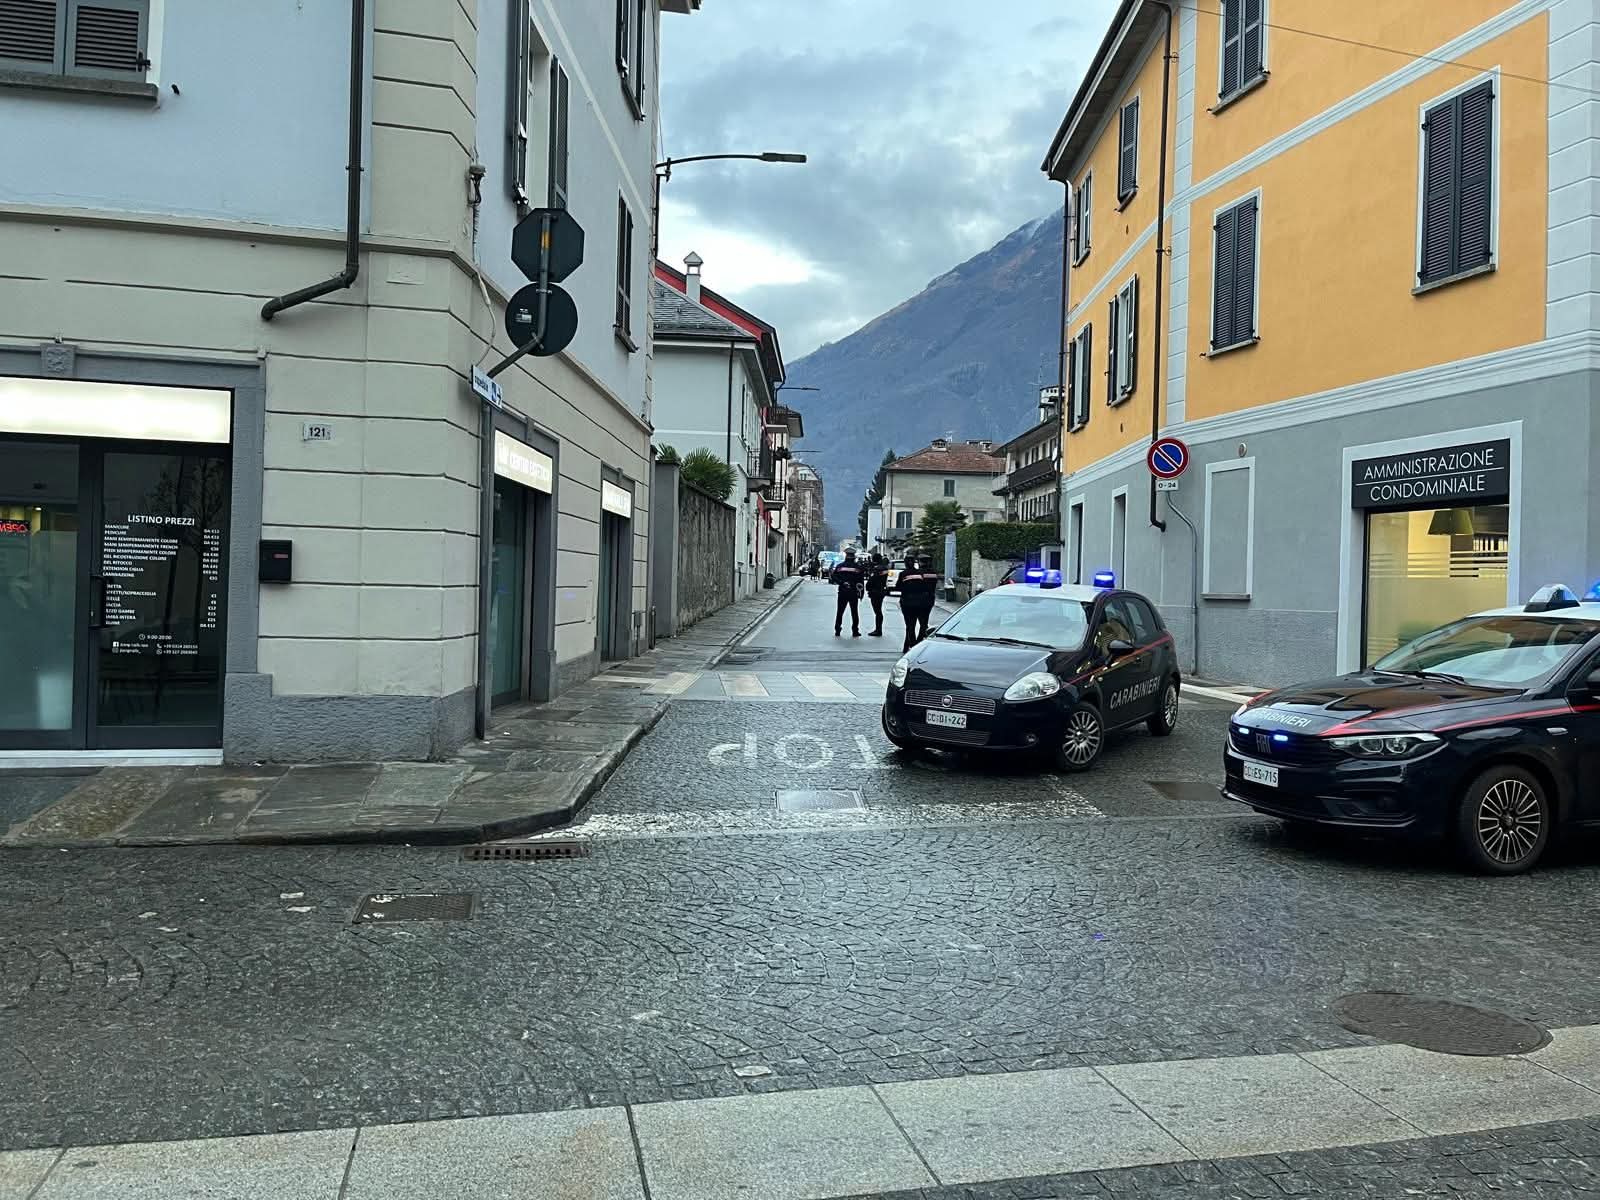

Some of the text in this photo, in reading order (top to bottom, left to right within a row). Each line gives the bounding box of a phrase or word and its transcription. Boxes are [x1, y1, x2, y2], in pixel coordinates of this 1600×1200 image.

[310, 427, 325, 437] 121
[1363, 448, 1494, 480] AMMINISTRAZIONE
[1370, 474, 1485, 501] CONDOMINIALE
[127, 515, 195, 526] LISTINO PREZZI
[1110, 675, 1161, 710] CARABINIERI
[707, 732, 902, 769] TOP
